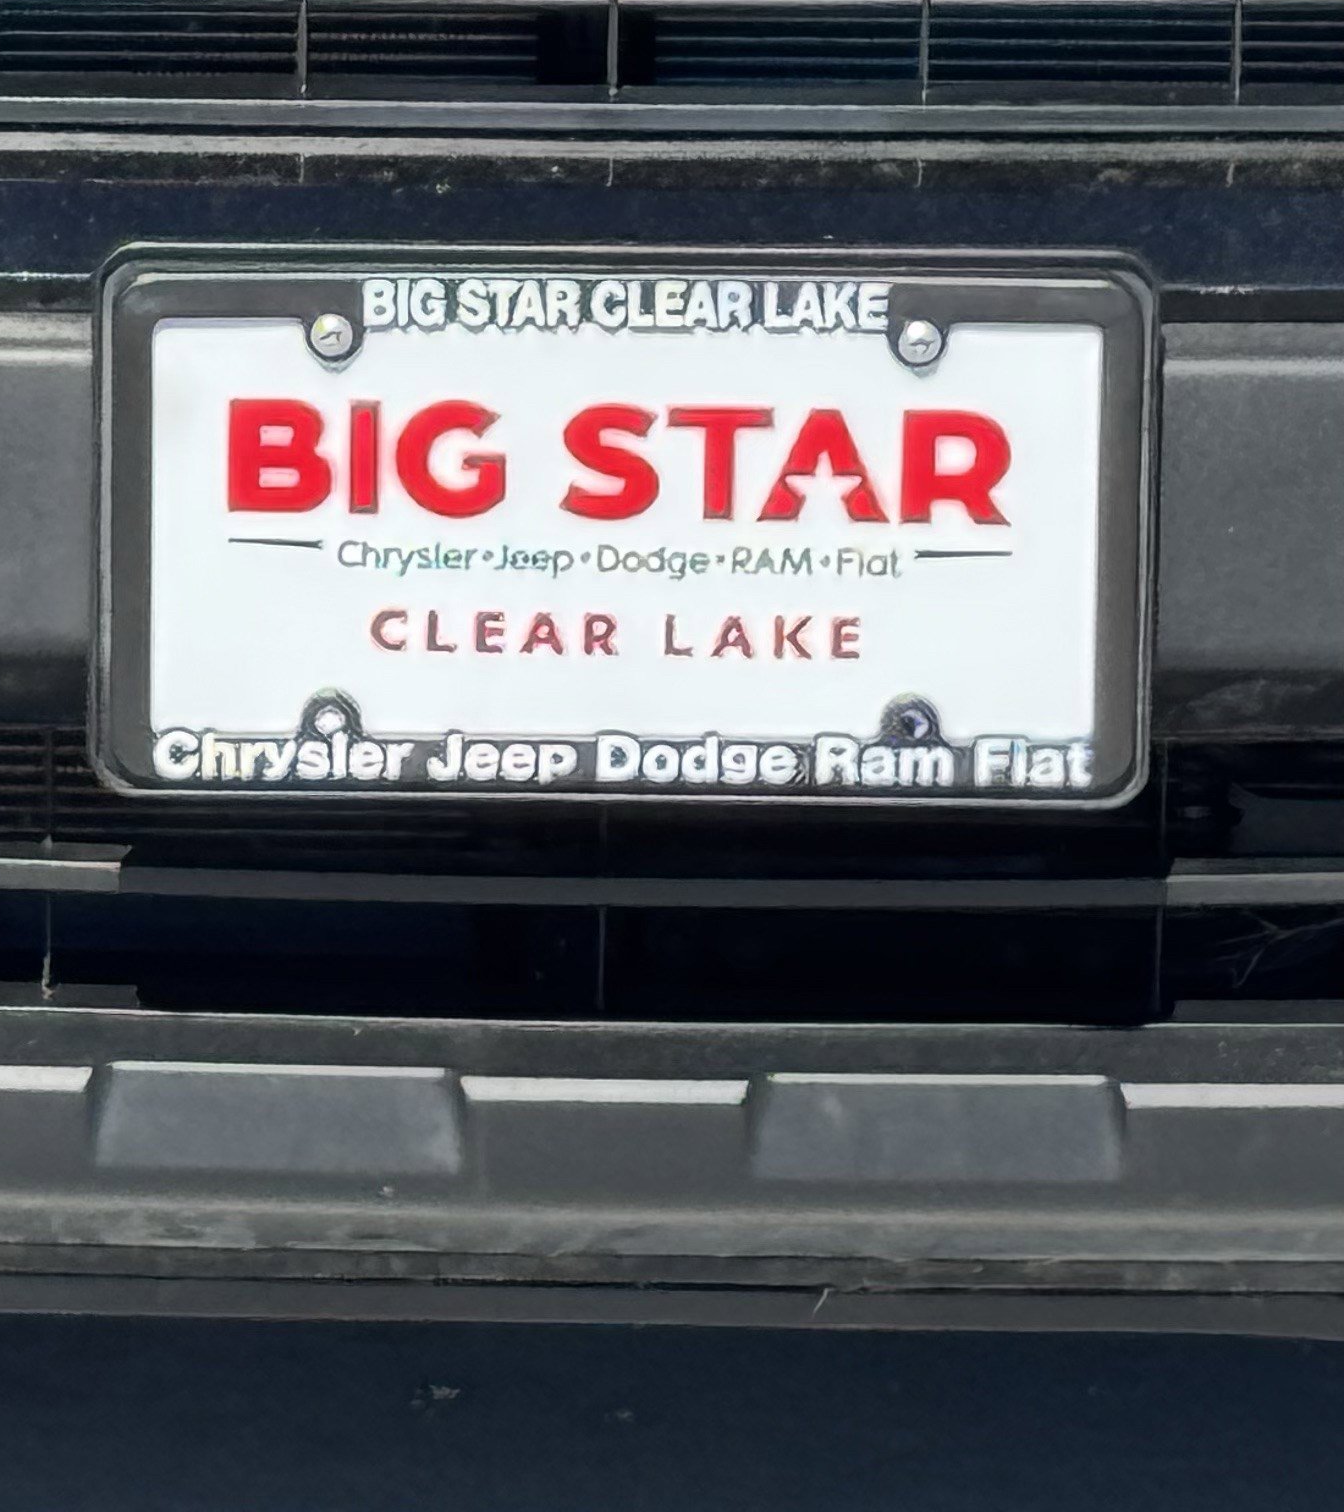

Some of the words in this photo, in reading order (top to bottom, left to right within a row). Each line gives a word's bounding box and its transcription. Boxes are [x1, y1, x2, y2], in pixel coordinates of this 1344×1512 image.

[362, 278, 448, 328] BIG
[456, 278, 583, 328] STAR
[590, 280, 753, 329] CLEAR
[762, 282, 890, 331] LAKE
[227, 398, 508, 520] BIG
[559, 402, 1013, 528] STAR
[337, 540, 478, 576] Chrysler
[596, 544, 710, 580] Dodge
[731, 546, 812, 575] RAM
[369, 609, 619, 656] CLEAR
[663, 613, 862, 660] LAKE
[152, 730, 414, 782] Chrysler
[426, 733, 579, 785] Jeep
[596, 735, 800, 785] Dodge
[815, 736, 956, 787] Ram
